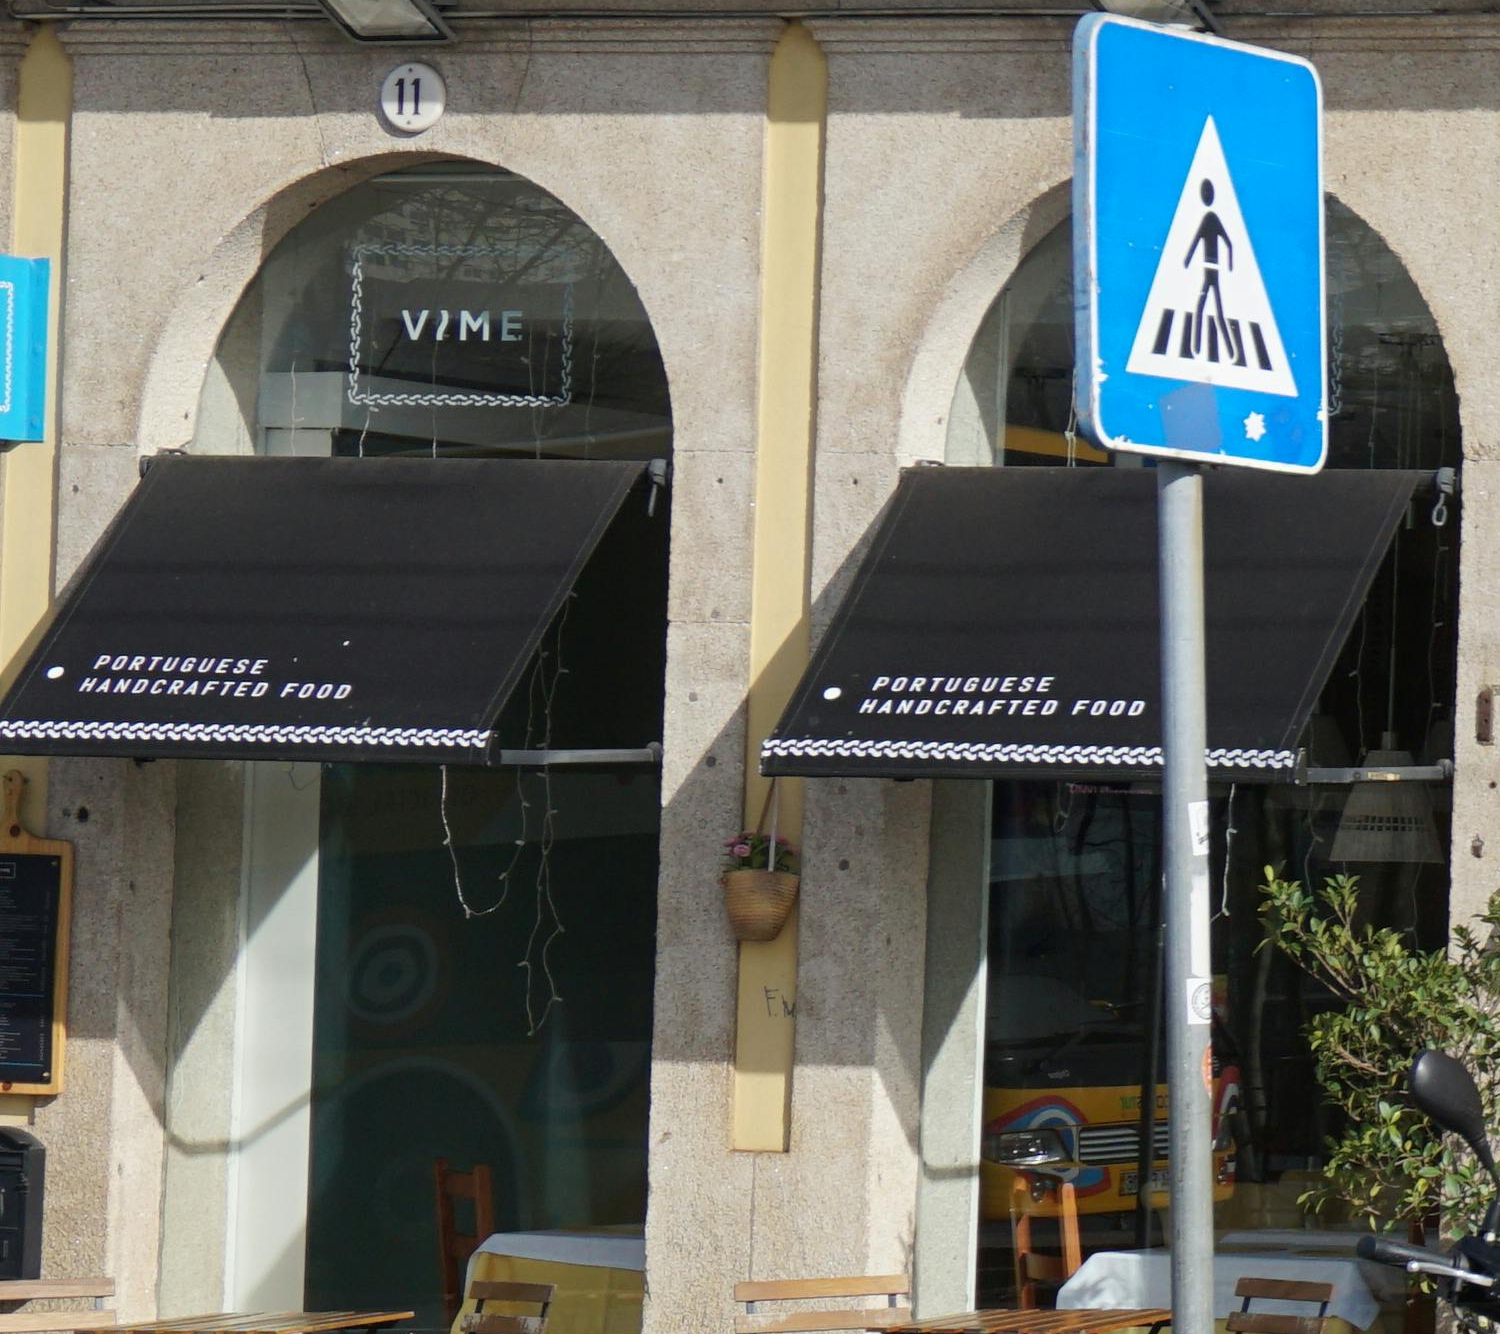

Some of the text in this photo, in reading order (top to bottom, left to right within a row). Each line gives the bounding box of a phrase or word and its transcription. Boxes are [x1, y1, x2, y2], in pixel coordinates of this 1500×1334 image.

[394, 78, 421, 115] 11
[93, 654, 269, 675] PORTUGUESE
[78, 677, 352, 700] HANDCRAFTED FOOD
[871, 676, 1056, 693] PORTUGUESE
[859, 698, 1147, 717] HANDCRAFTED FOOD
